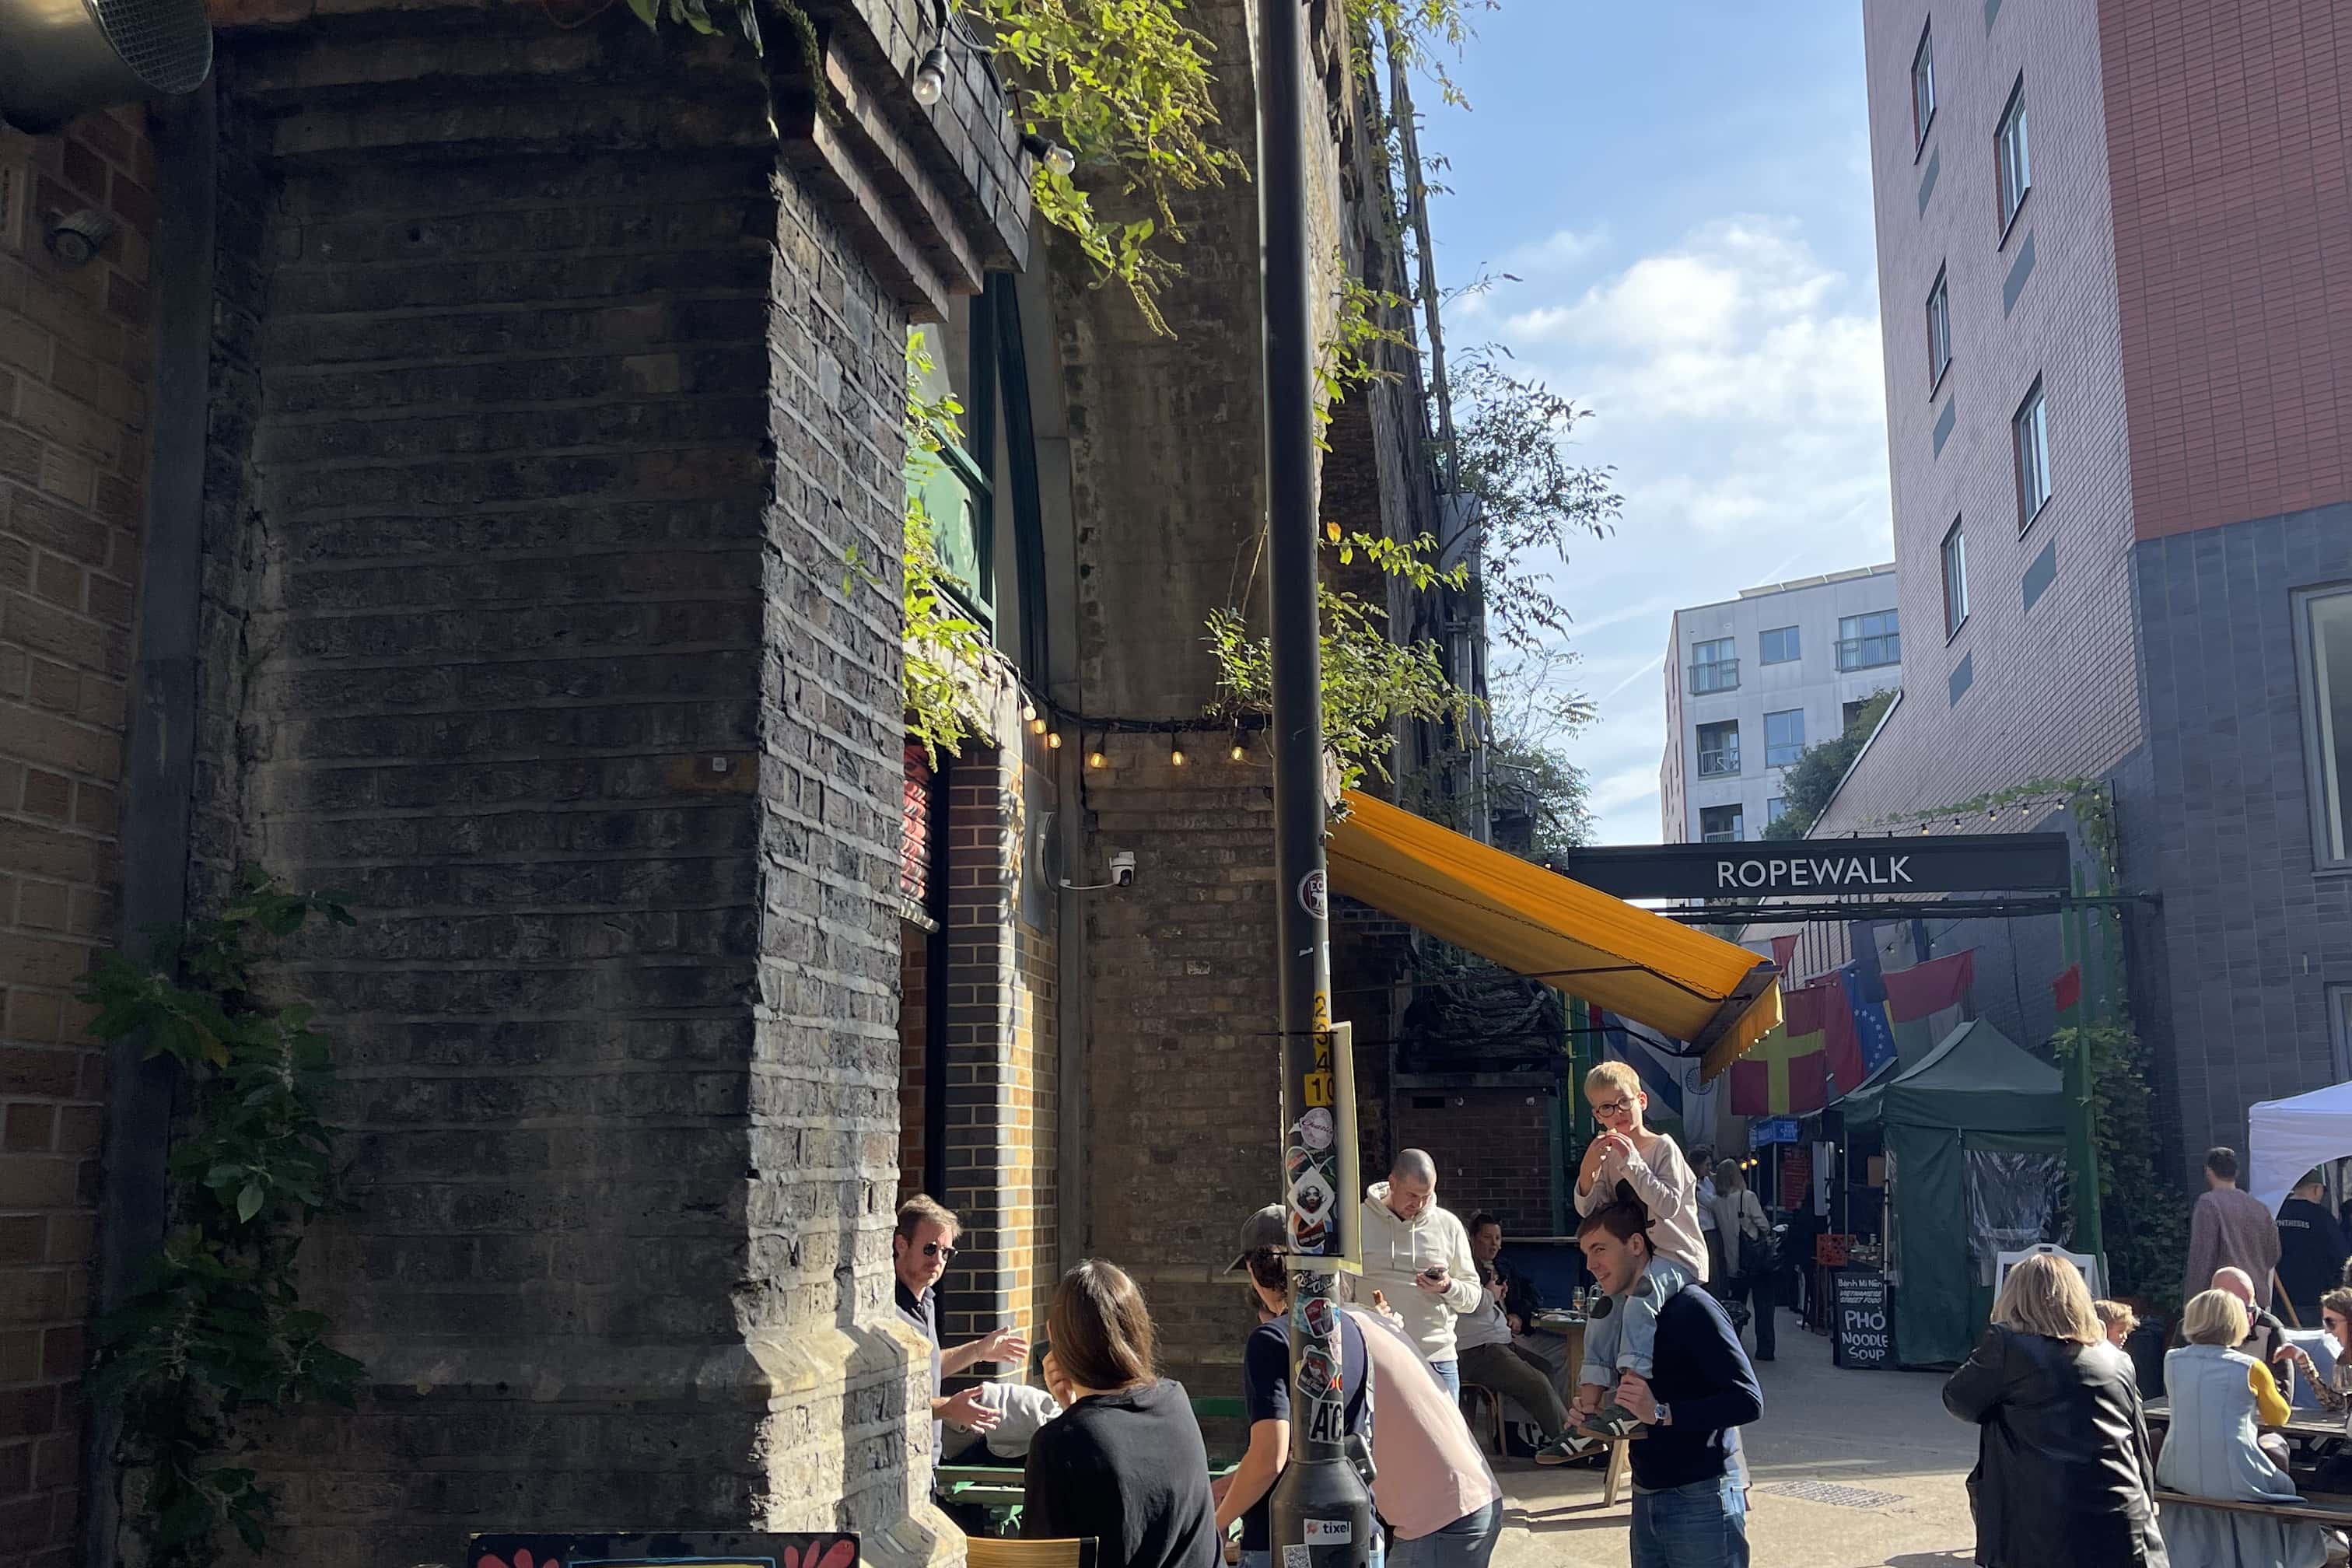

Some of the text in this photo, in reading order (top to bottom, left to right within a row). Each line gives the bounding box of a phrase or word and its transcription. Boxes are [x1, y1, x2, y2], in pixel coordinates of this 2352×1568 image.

[1717, 856, 1913, 888] ROPEWALK
[1841, 1332, 1888, 1347] NOODLE
[1848, 1346, 1885, 1361] SOUP
[1322, 1521, 1350, 1535] tixel
